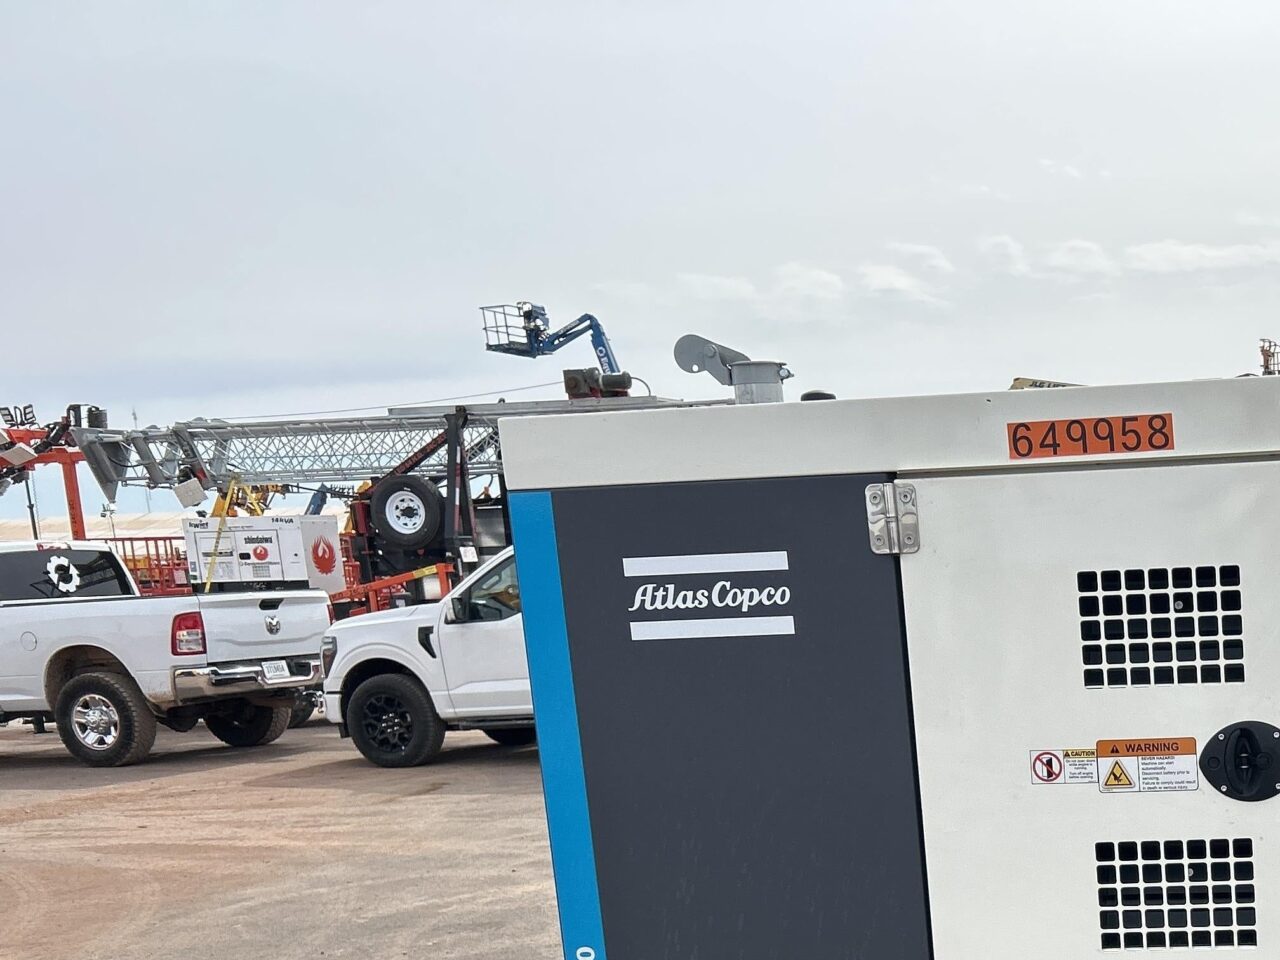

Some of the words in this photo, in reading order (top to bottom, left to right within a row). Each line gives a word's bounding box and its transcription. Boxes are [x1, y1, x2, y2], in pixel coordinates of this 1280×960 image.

[1012, 414, 1170, 458] 649958
[627, 583, 709, 612] Atlas
[711, 580, 791, 612] Copco
[1125, 742, 1180, 753] WARNING
